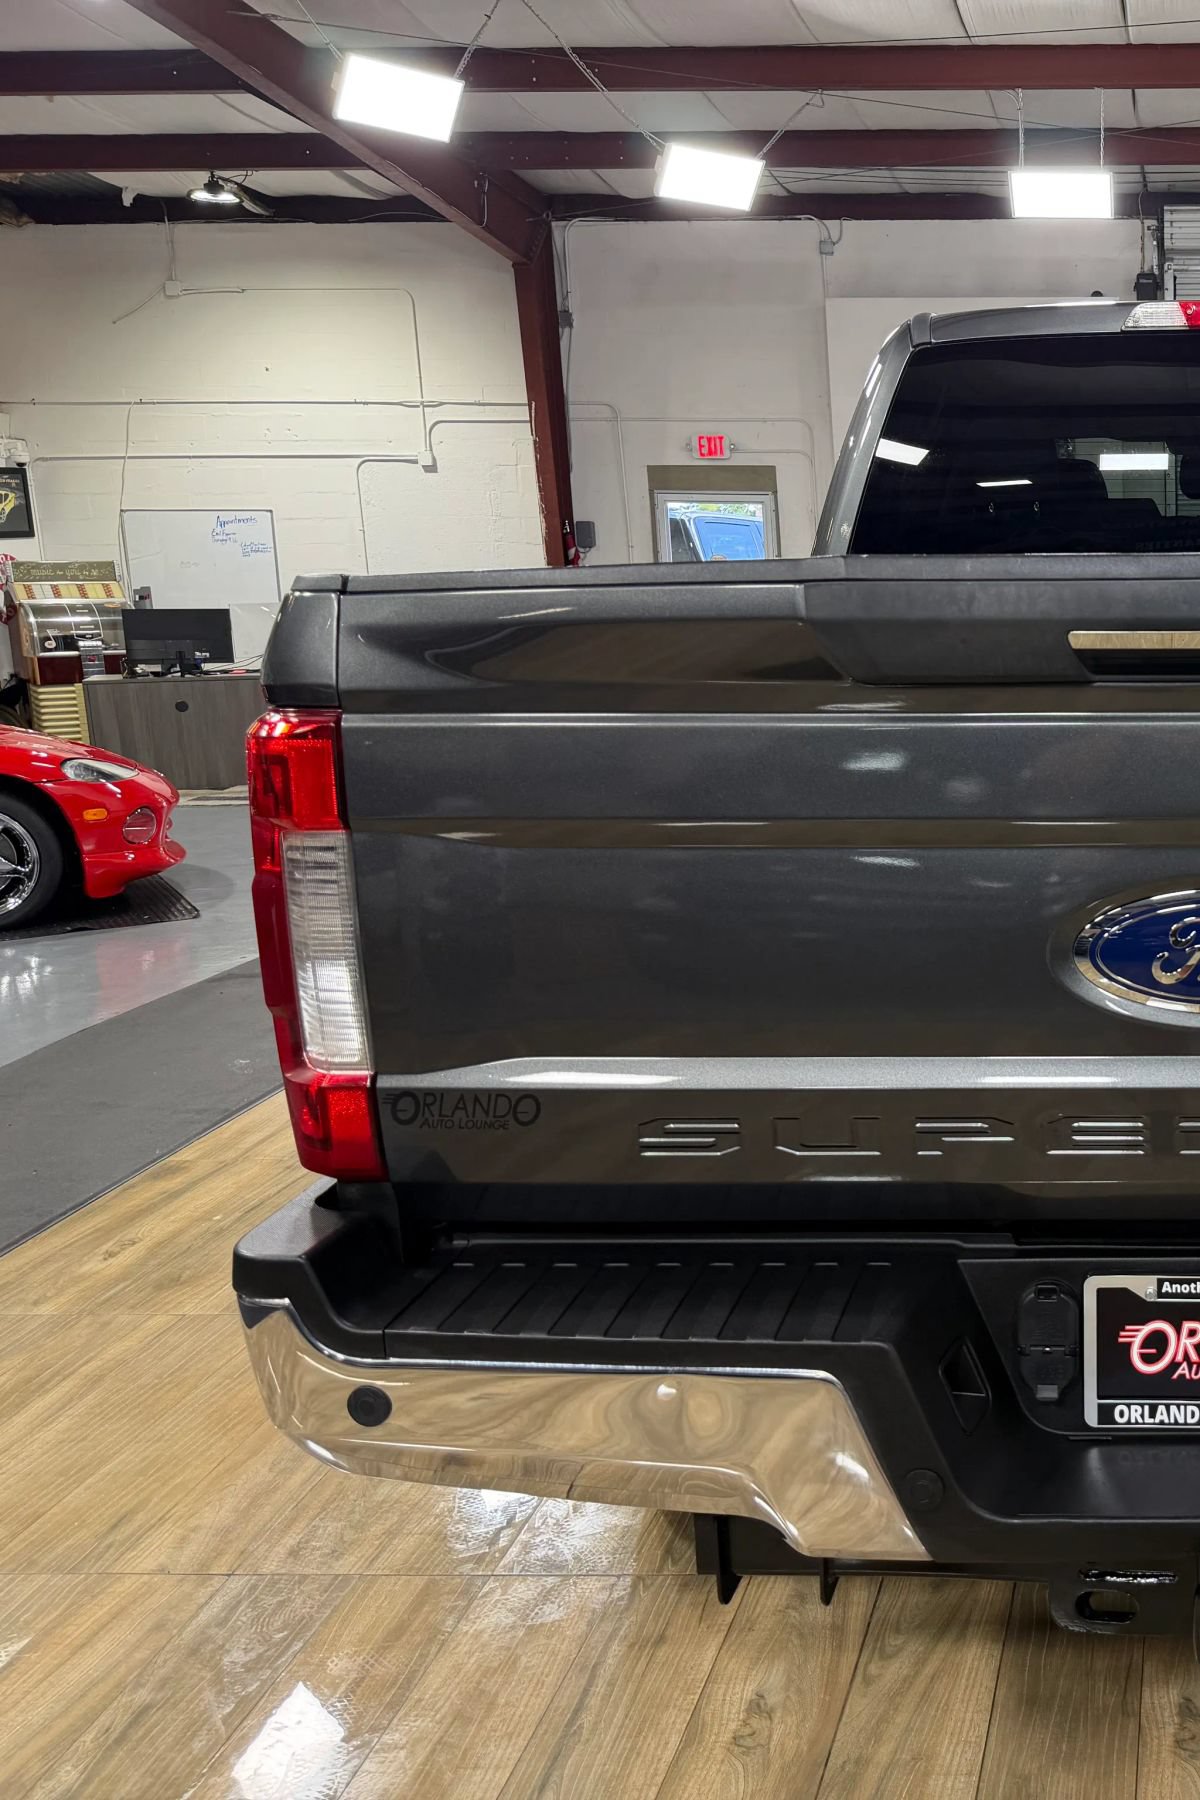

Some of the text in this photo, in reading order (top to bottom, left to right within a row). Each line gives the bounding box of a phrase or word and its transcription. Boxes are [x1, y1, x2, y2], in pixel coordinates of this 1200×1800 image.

[698, 436, 724, 457] EXIT
[388, 1091, 541, 1127] ORLANDO
[419, 1118, 511, 1131] AUTO LOUNGE
